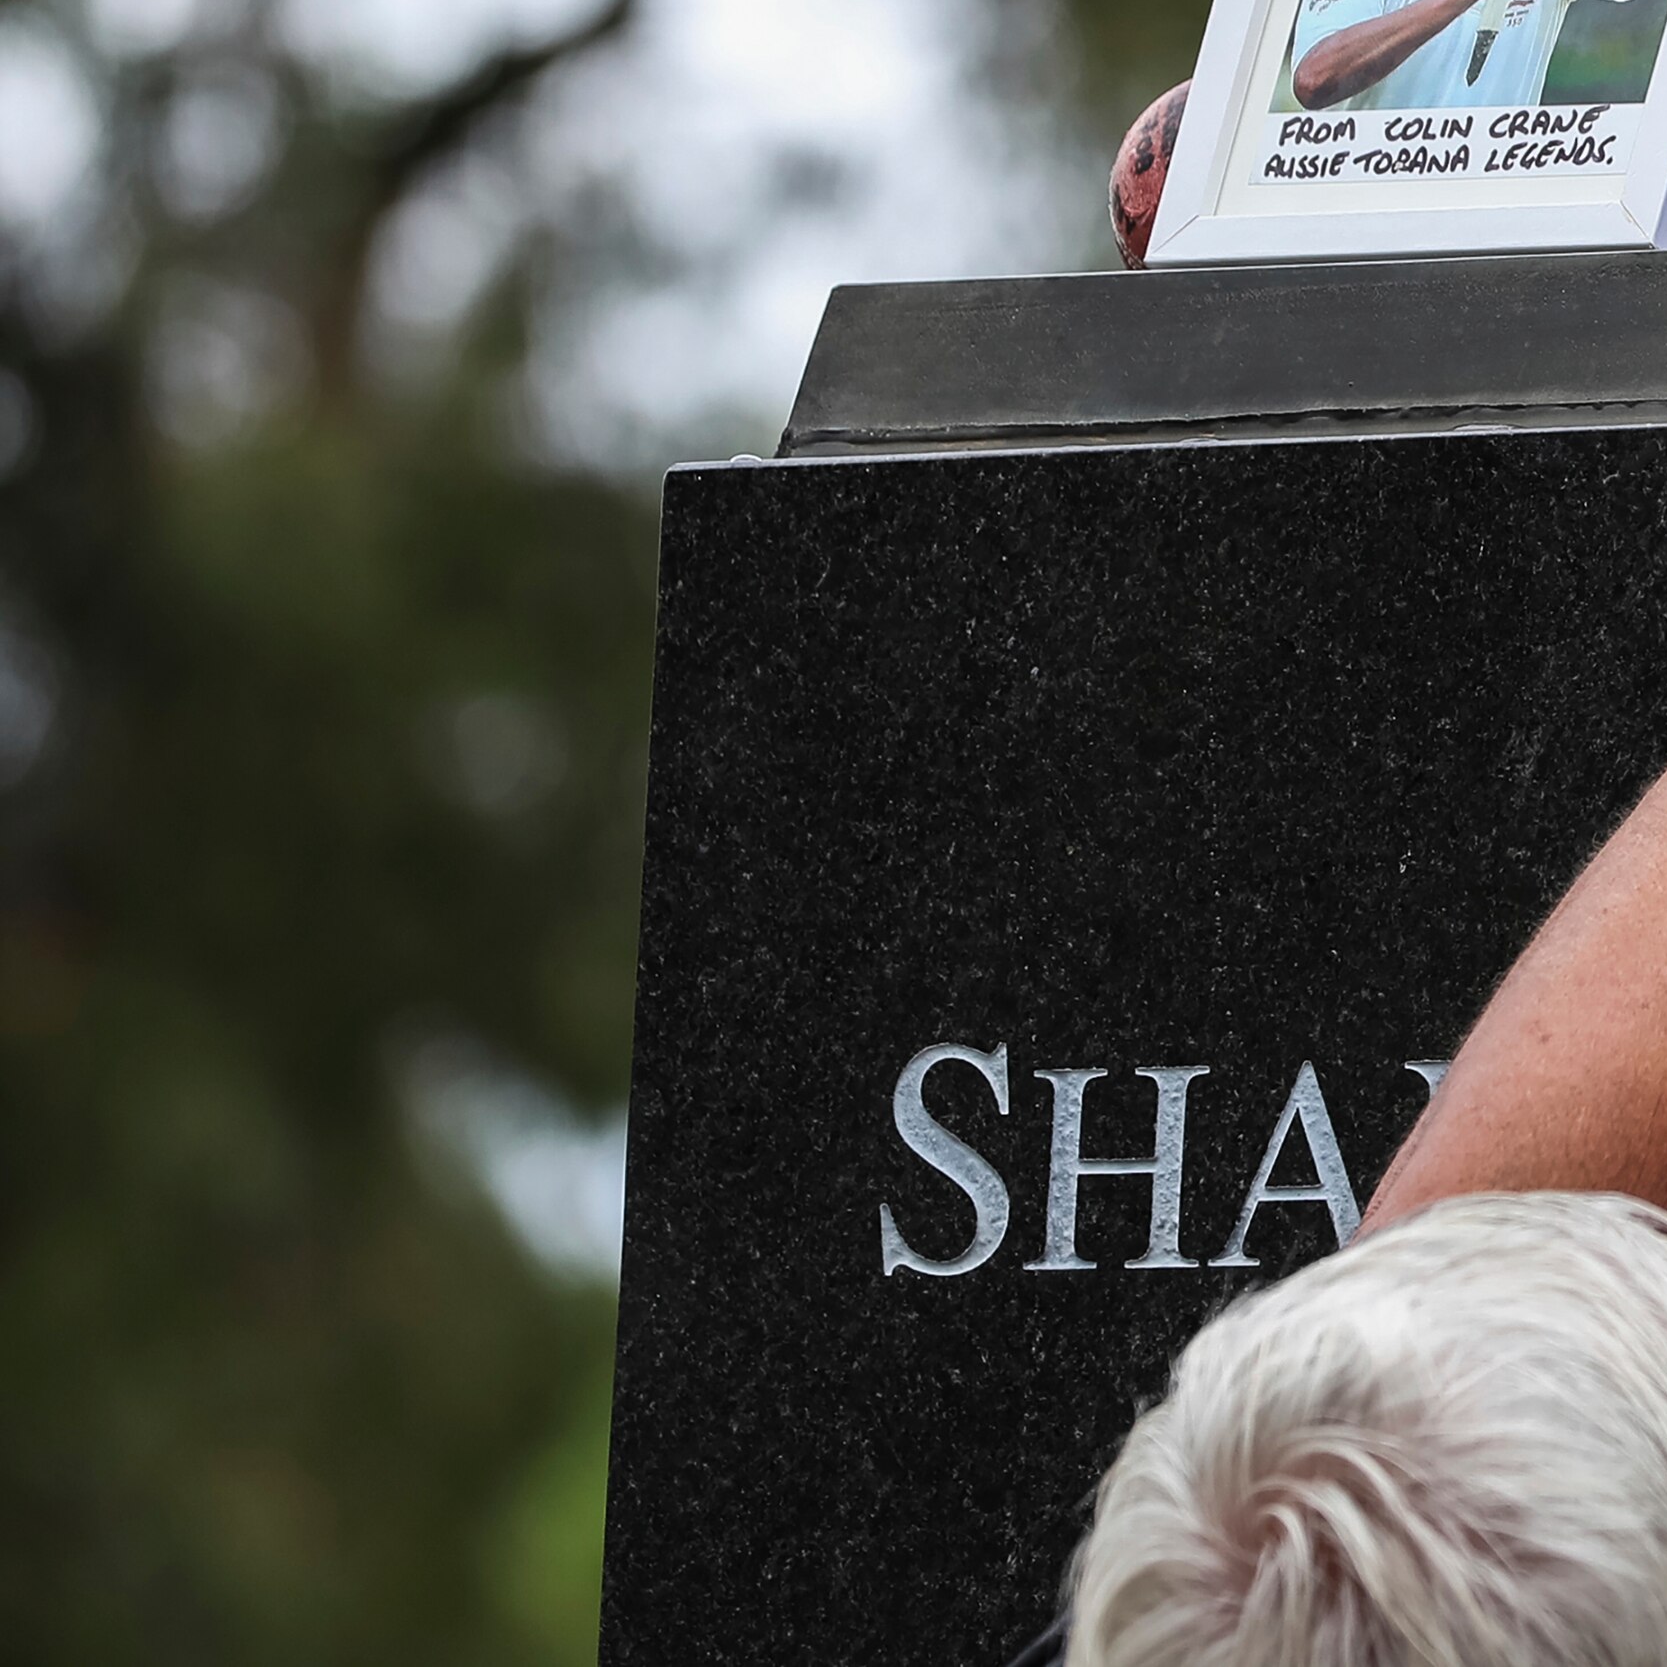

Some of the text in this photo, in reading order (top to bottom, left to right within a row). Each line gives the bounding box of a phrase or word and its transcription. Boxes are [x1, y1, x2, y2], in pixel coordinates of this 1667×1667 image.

[1279, 103, 1611, 146] FROM COLIN CRANE
[1264, 150, 1350, 179] AUSSIE
[879, 1042, 1450, 1277] SHA
